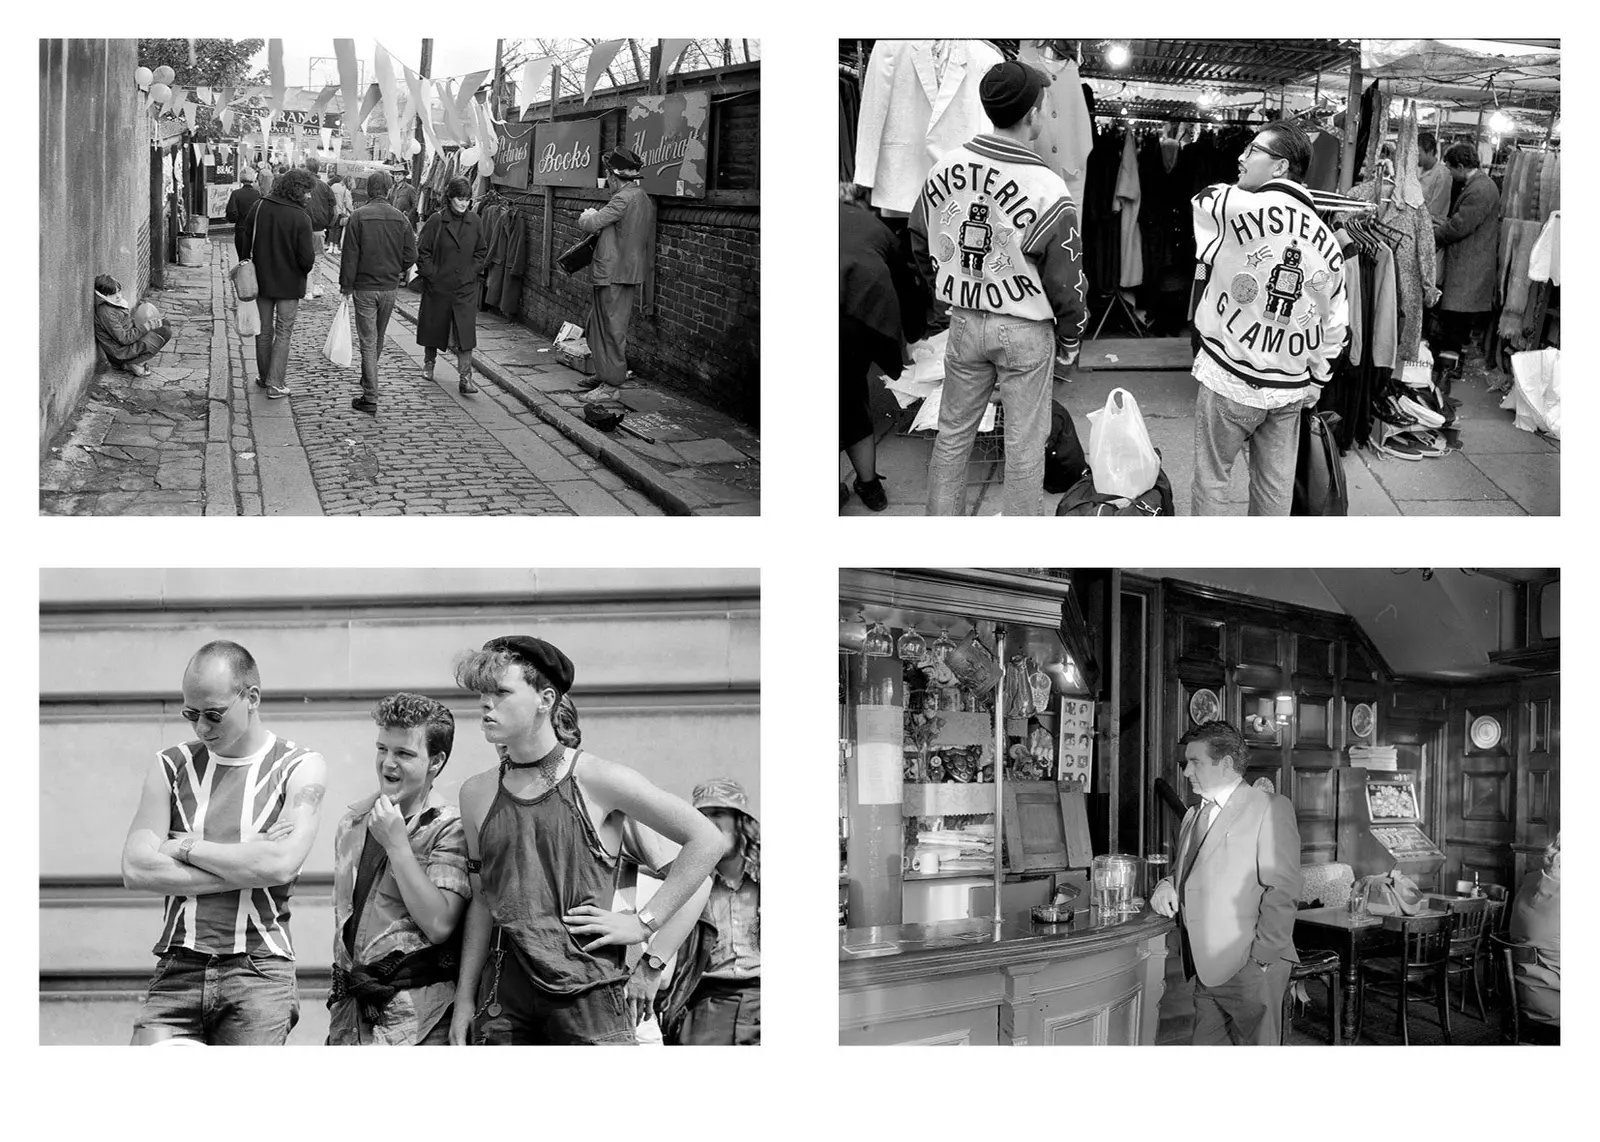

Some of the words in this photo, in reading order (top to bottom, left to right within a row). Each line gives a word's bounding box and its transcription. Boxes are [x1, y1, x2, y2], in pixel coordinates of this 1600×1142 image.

[539, 140, 591, 174] Books
[926, 162, 1037, 230] HYSTERIC
[1230, 205, 1343, 273] HYSTERIC
[1216, 291, 1325, 357] GLAMOU
